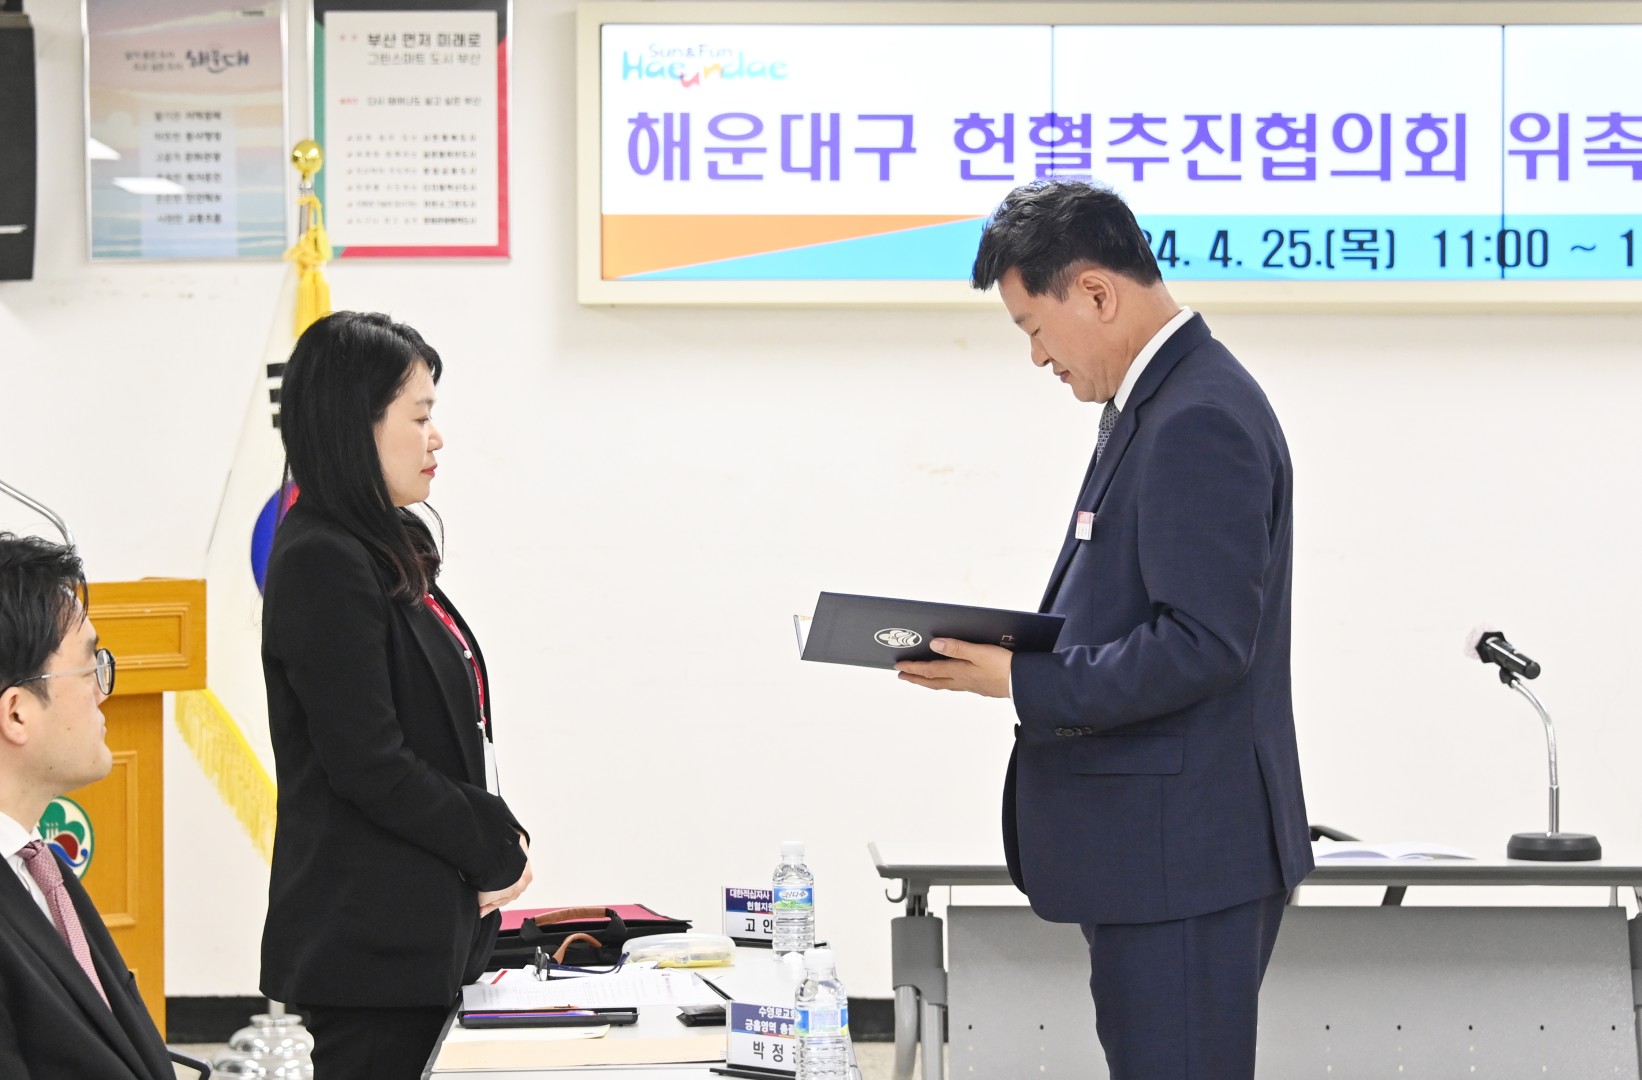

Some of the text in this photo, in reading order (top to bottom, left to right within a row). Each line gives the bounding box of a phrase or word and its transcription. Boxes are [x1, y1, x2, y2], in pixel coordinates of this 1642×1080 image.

[367, 33, 397, 49] 부산
[402, 33, 432, 49] 먼저
[437, 33, 481, 48] 미래로
[622, 50, 788, 88] Haeundae
[626, 112, 1642, 182] 해운대구 헌혈추진협의회 위촉
[1142, 229, 1190, 268] 4.
[1209, 229, 1243, 268] 4.
[1433, 229, 1549, 268] 11:00
[729, 888, 770, 900] 대한적십자사
